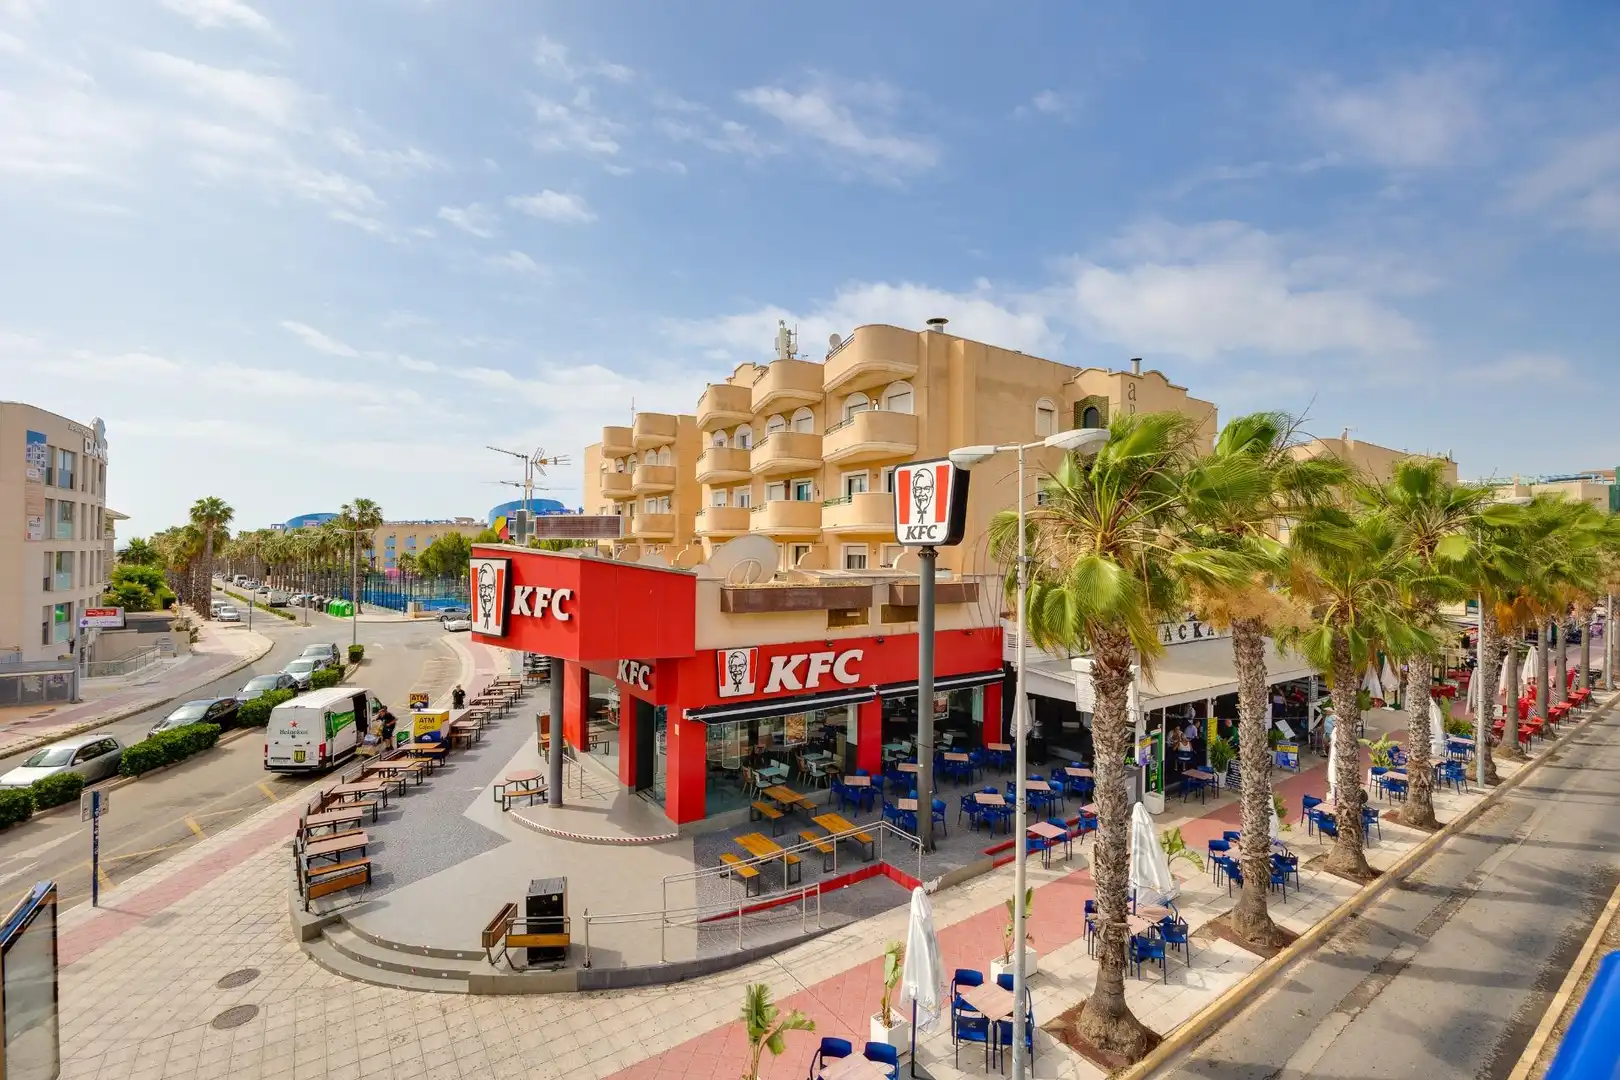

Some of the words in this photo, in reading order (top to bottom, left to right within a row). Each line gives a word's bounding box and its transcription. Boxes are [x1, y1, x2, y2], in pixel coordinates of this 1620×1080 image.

[905, 524, 938, 541] KFC
[511, 585, 571, 621] KFC
[616, 659, 650, 691] KFC
[763, 648, 864, 694] KFC
